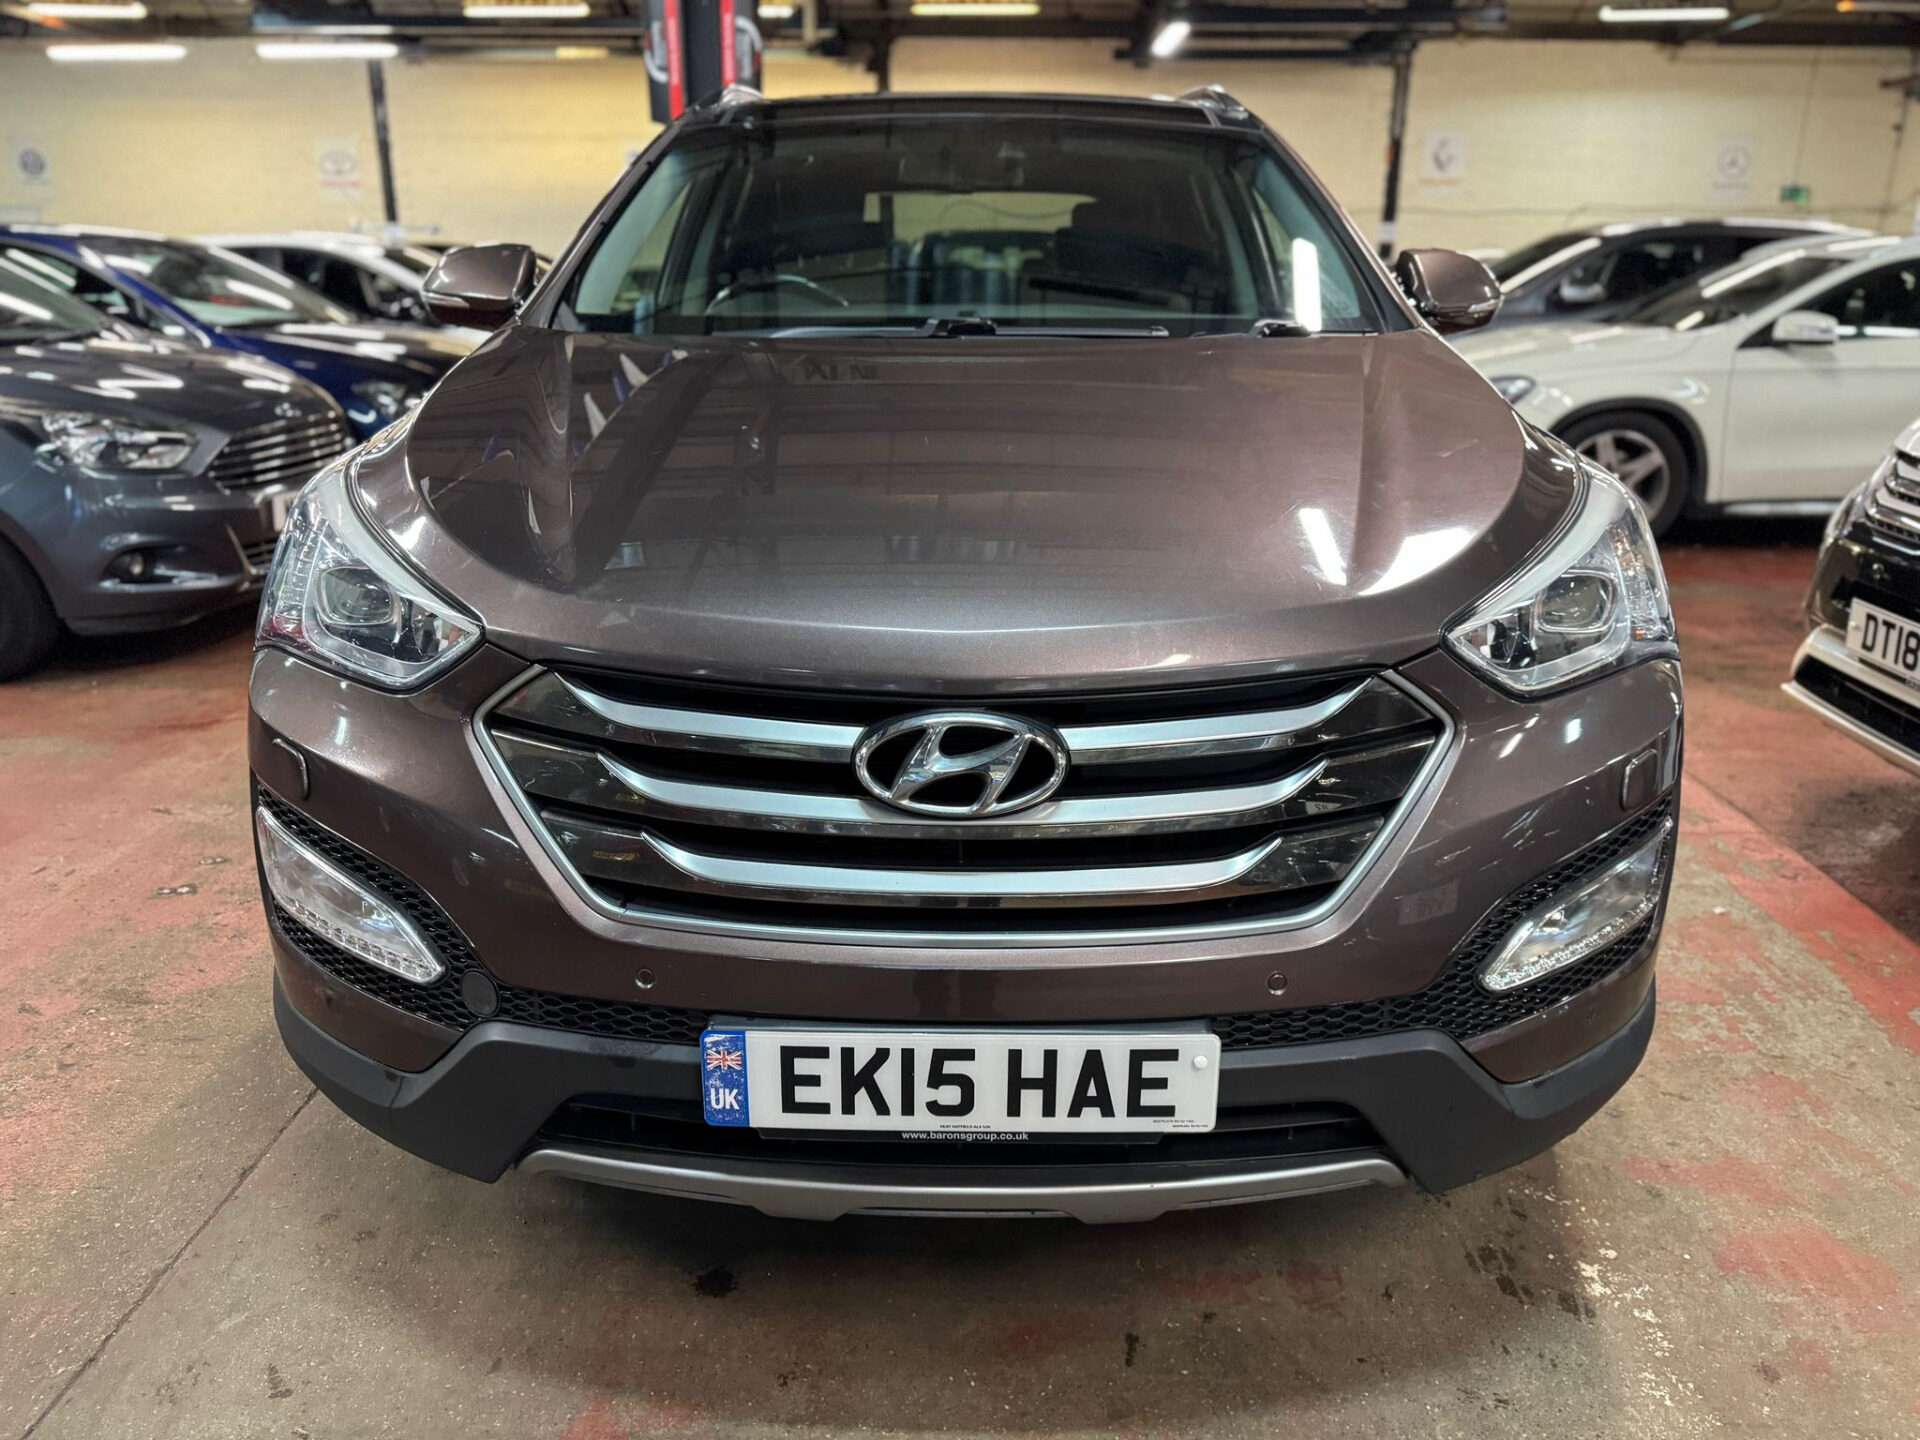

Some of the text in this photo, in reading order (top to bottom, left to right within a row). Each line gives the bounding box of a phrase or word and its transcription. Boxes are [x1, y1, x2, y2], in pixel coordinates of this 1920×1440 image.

[1861, 612, 1920, 671] DT18
[710, 1087, 740, 1110] UK
[780, 1045, 1179, 1118] EK15 HAE
[901, 1131, 1029, 1142] www.baronsgroup.co.uk
